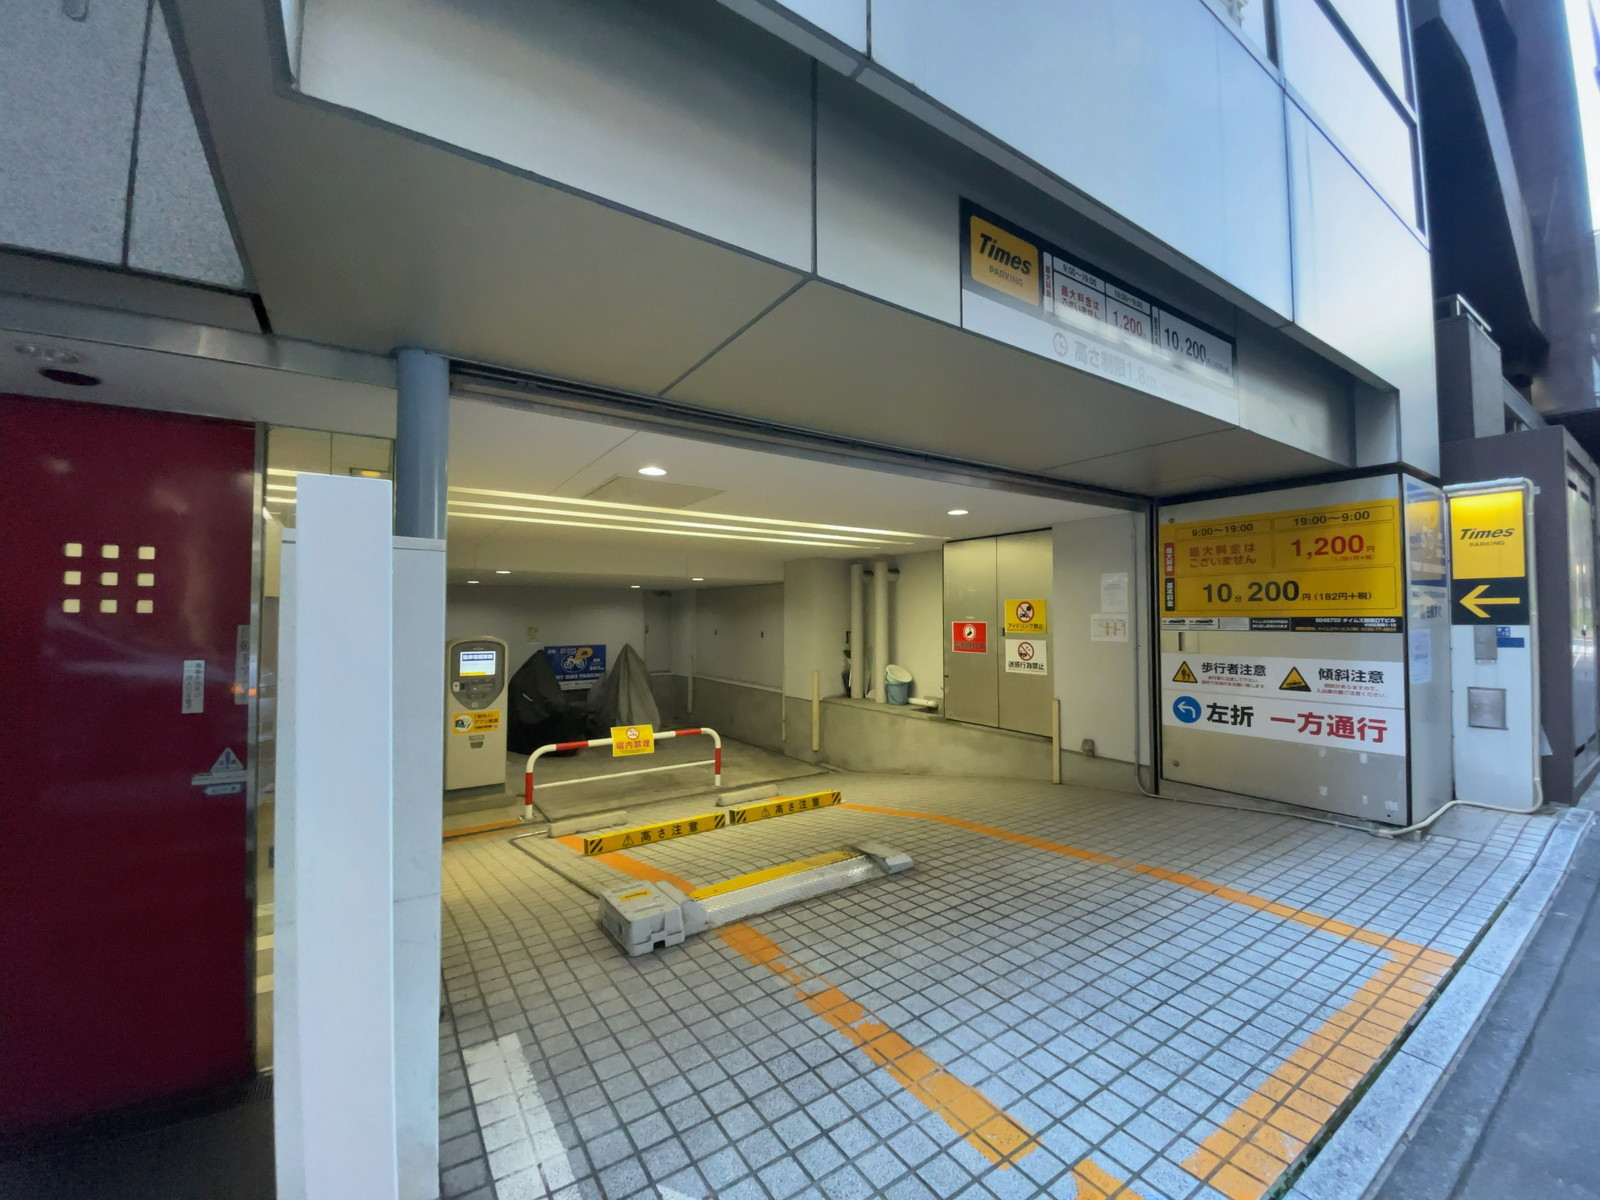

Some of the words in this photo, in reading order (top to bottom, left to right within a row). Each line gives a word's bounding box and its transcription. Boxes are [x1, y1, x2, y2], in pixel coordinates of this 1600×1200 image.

[979, 232, 1032, 276] Times
[988, 264, 1024, 288] PARKING
[1061, 284, 1099, 311] 最大料金は
[1294, 510, 1370, 527] 19:00～9:00
[1192, 523, 1254, 537] 9:00～19:00
[1460, 527, 1515, 541] Times
[1189, 543, 1256, 557] 最大料金は
[1189, 554, 1257, 568] ございません
[1201, 661, 1267, 677] 歩行者注意
[1318, 667, 1384, 684] 傾斜注意
[1206, 703, 1254, 728] 左折
[1270, 712, 1388, 743] 一方通行
[774, 796, 821, 815] 高さ注意
[640, 821, 699, 843] 高さ注意
